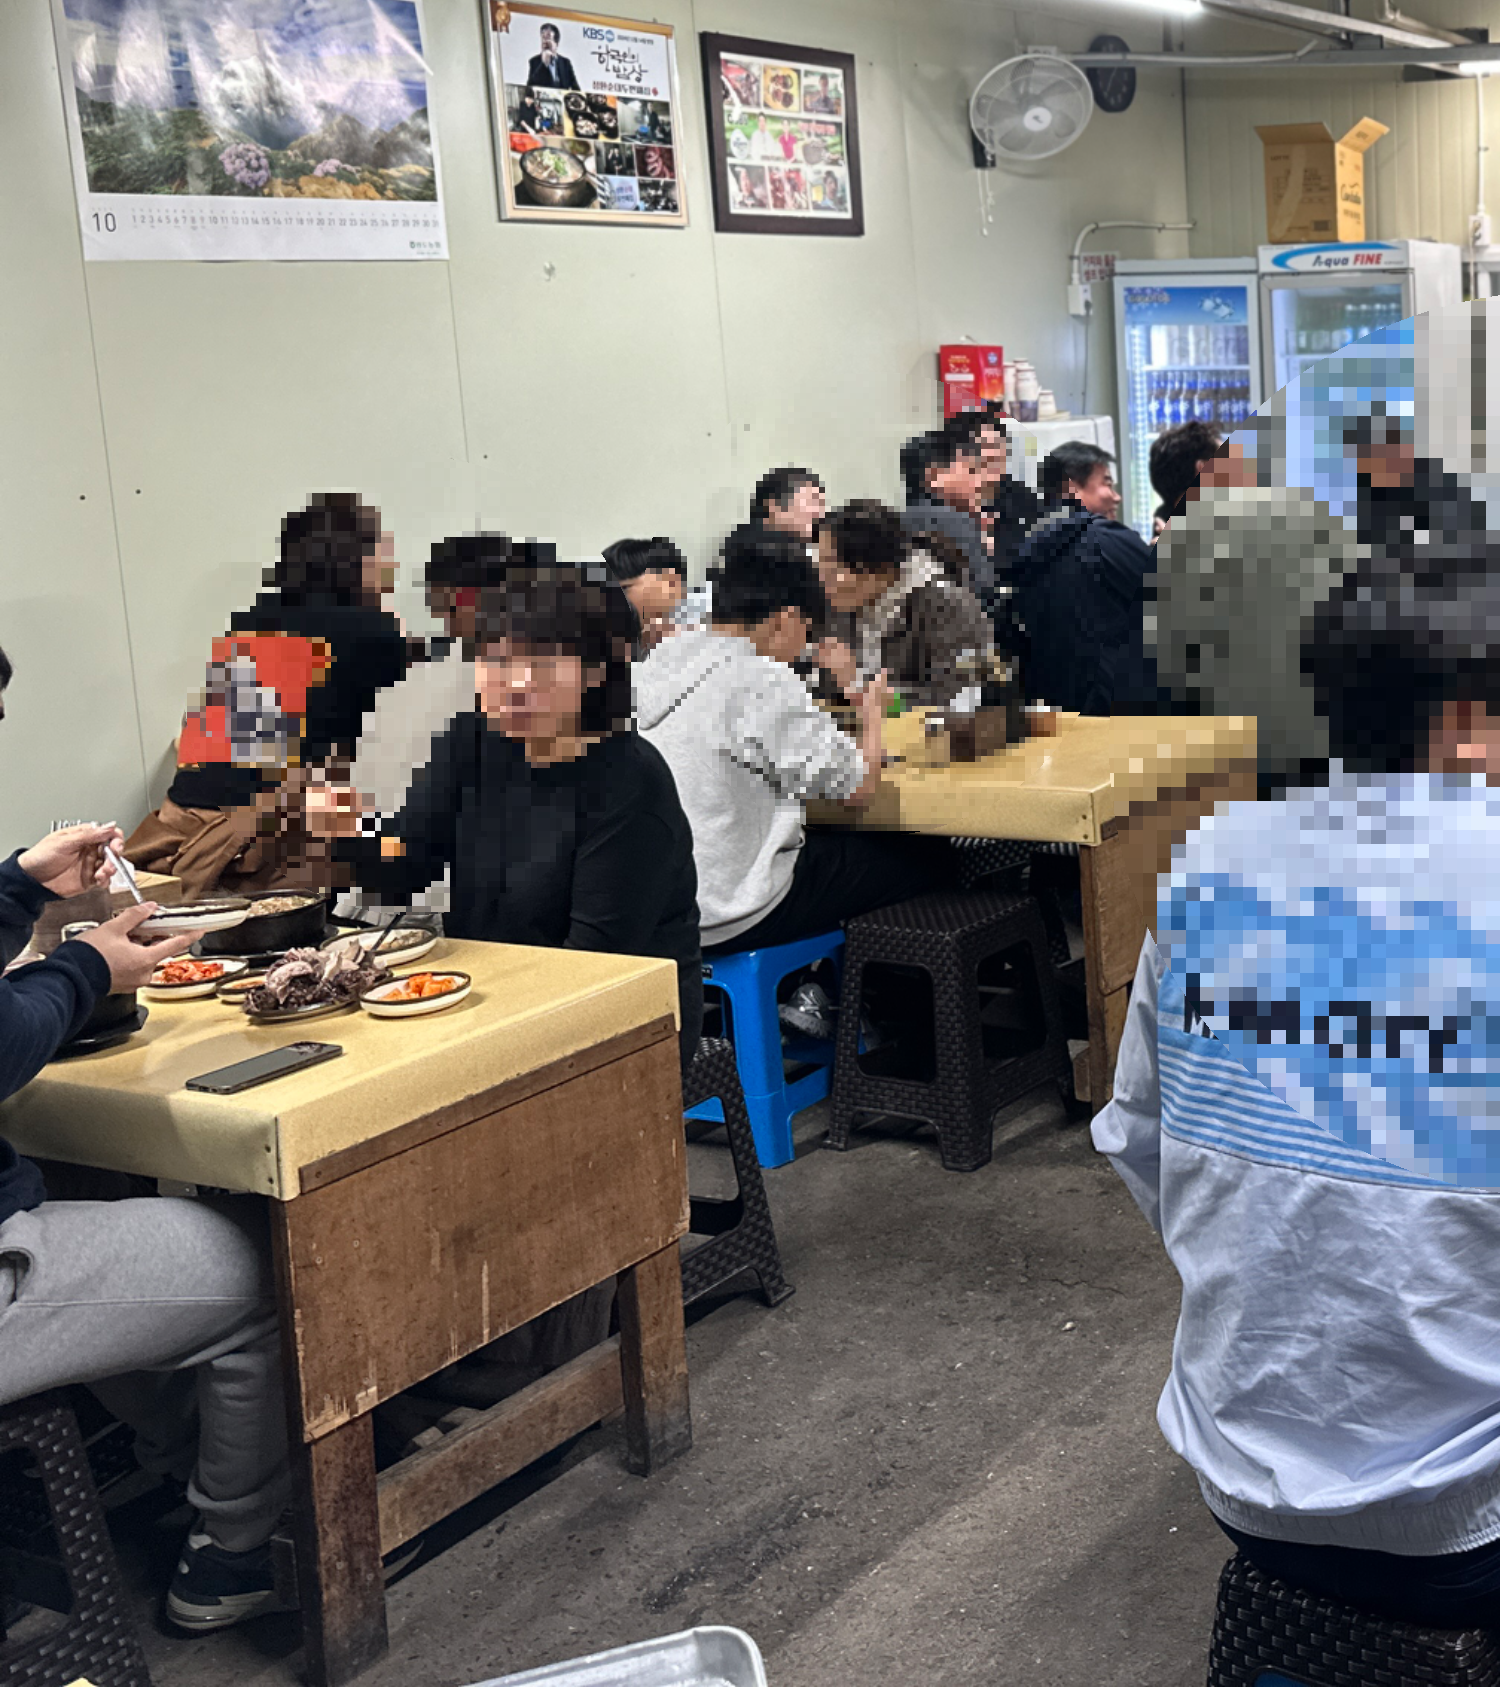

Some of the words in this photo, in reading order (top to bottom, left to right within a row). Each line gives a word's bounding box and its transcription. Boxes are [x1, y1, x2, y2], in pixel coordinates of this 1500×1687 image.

[583, 26, 605, 40] KBS
[92, 212, 116, 232] 10
[1312, 255, 1348, 268] Aqua
[1353, 253, 1383, 266] FINE
